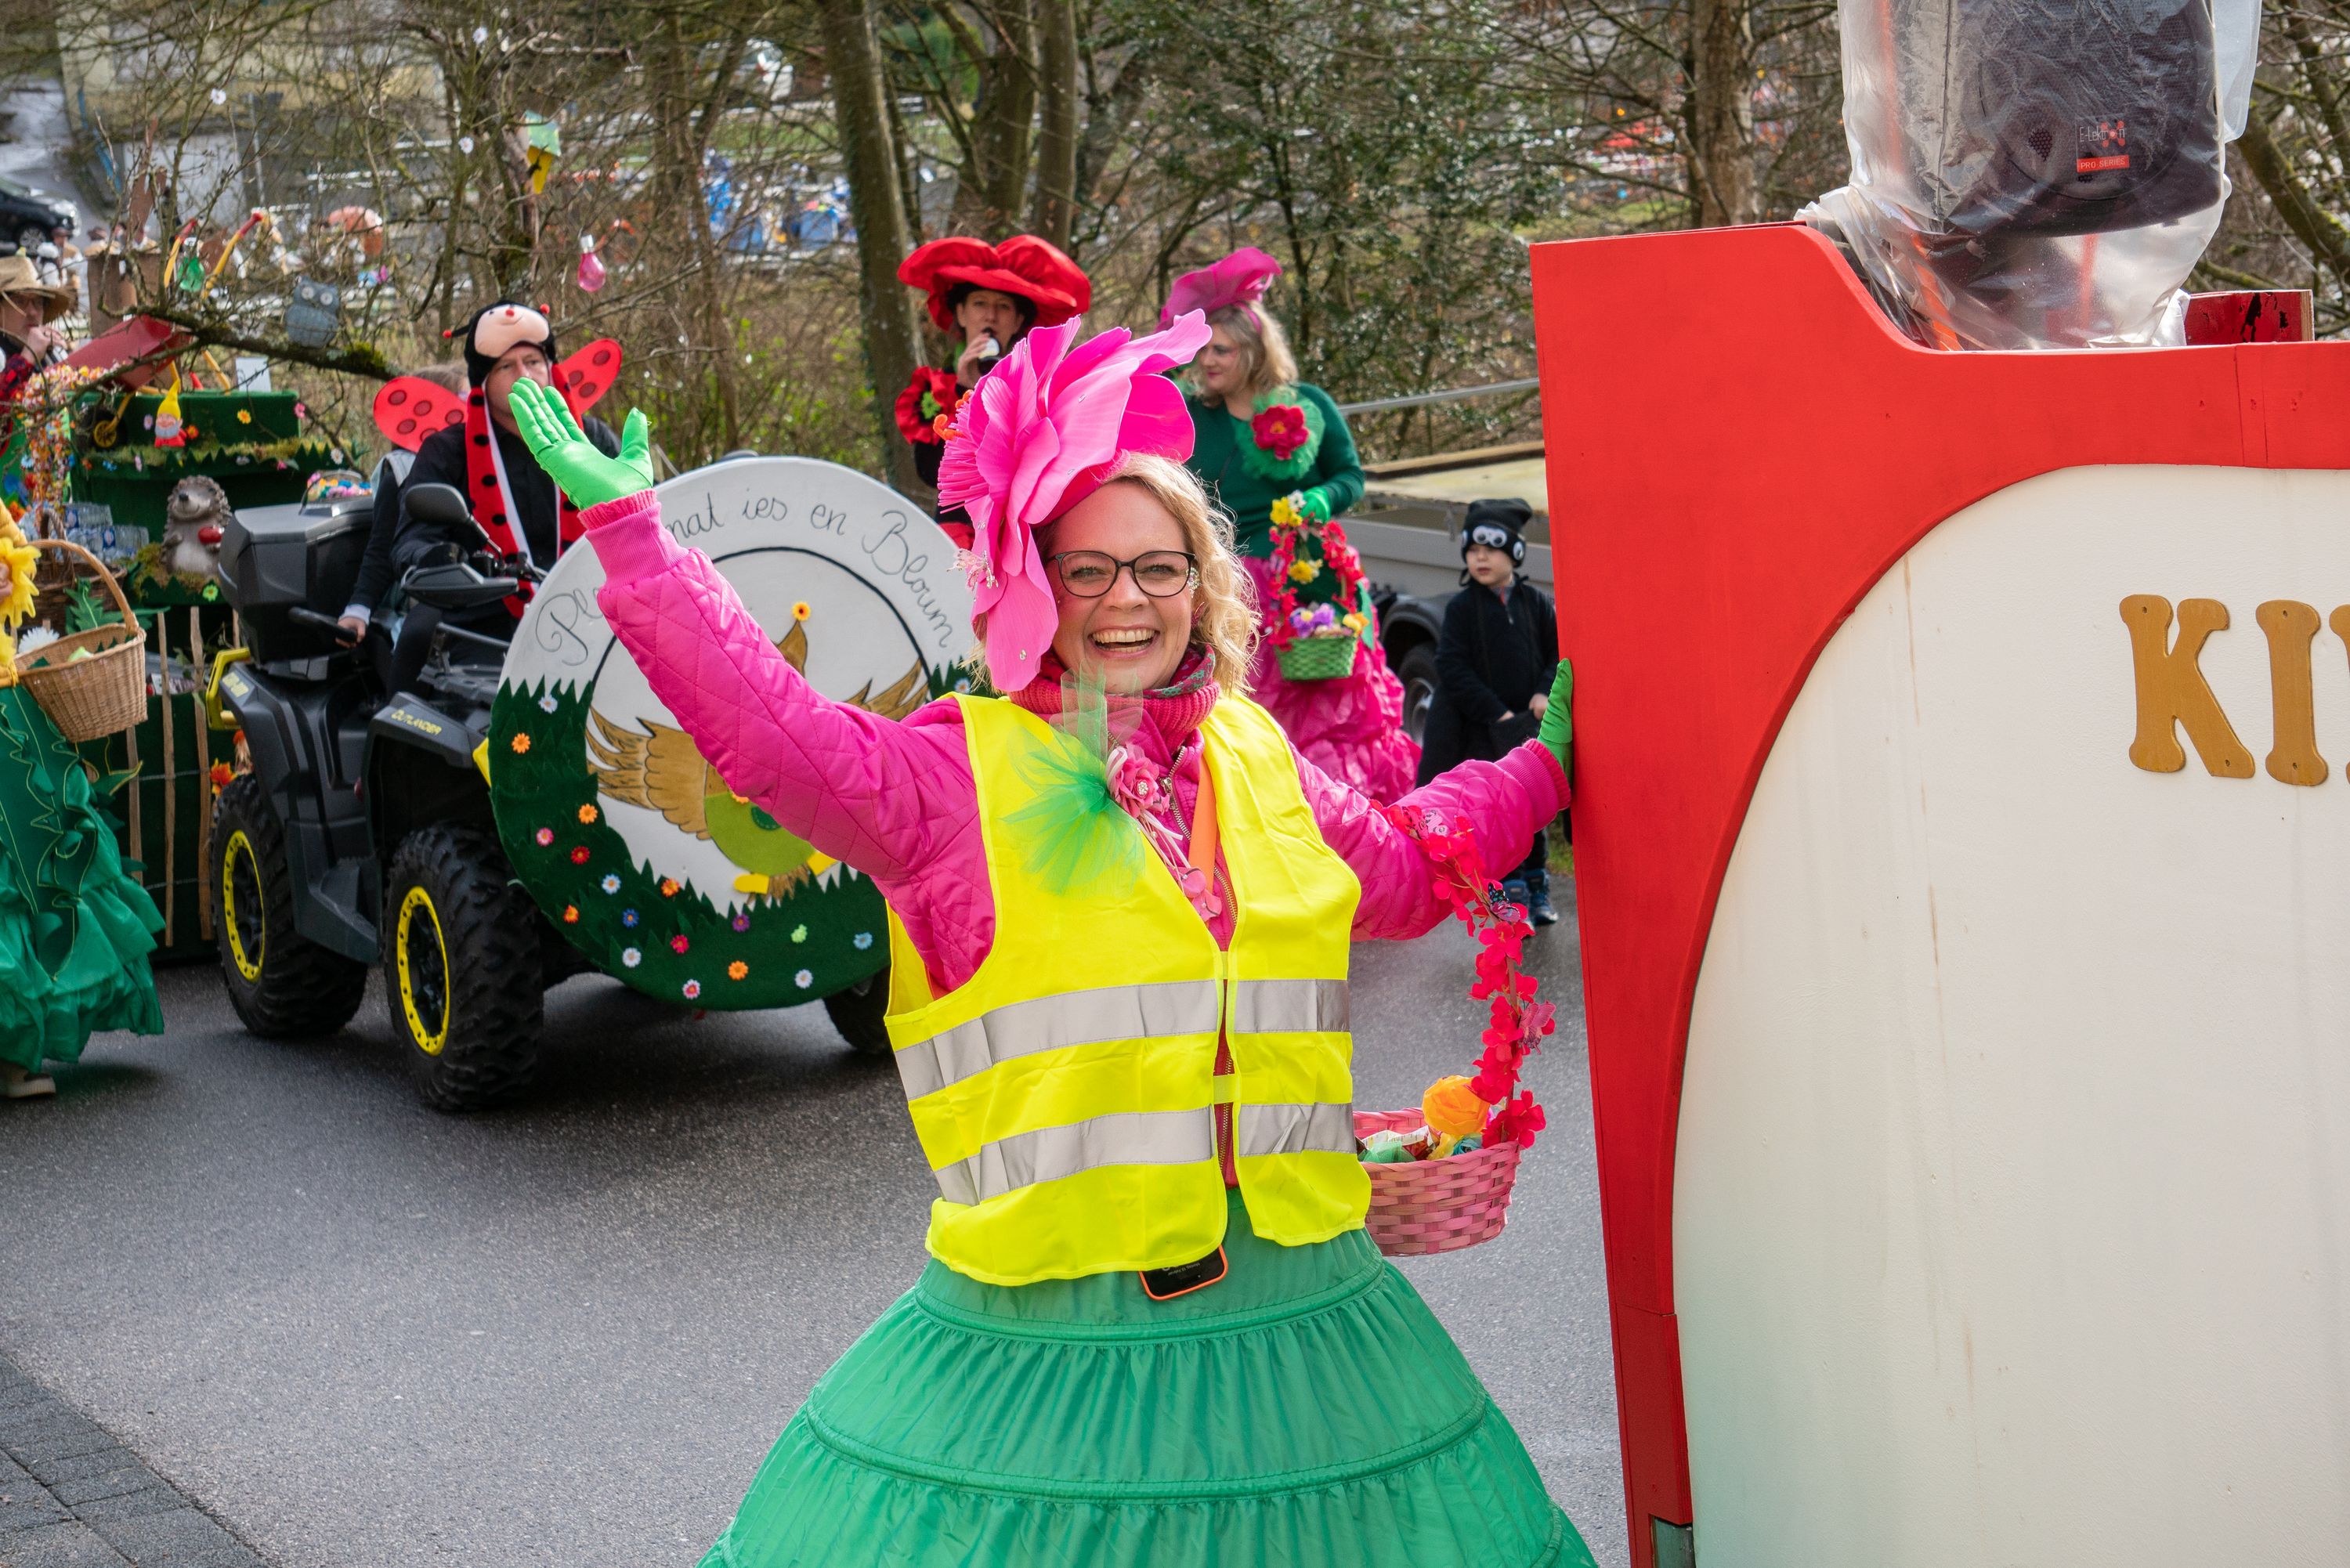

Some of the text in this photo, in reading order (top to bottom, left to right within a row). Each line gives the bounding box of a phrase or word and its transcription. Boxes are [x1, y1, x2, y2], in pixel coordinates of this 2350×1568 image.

[2099, 157, 2126, 168] SERIES
[536, 587, 603, 666] Pl
[742, 487, 788, 522] ies
[810, 504, 847, 536] en
[2119, 594, 2350, 787] KI
